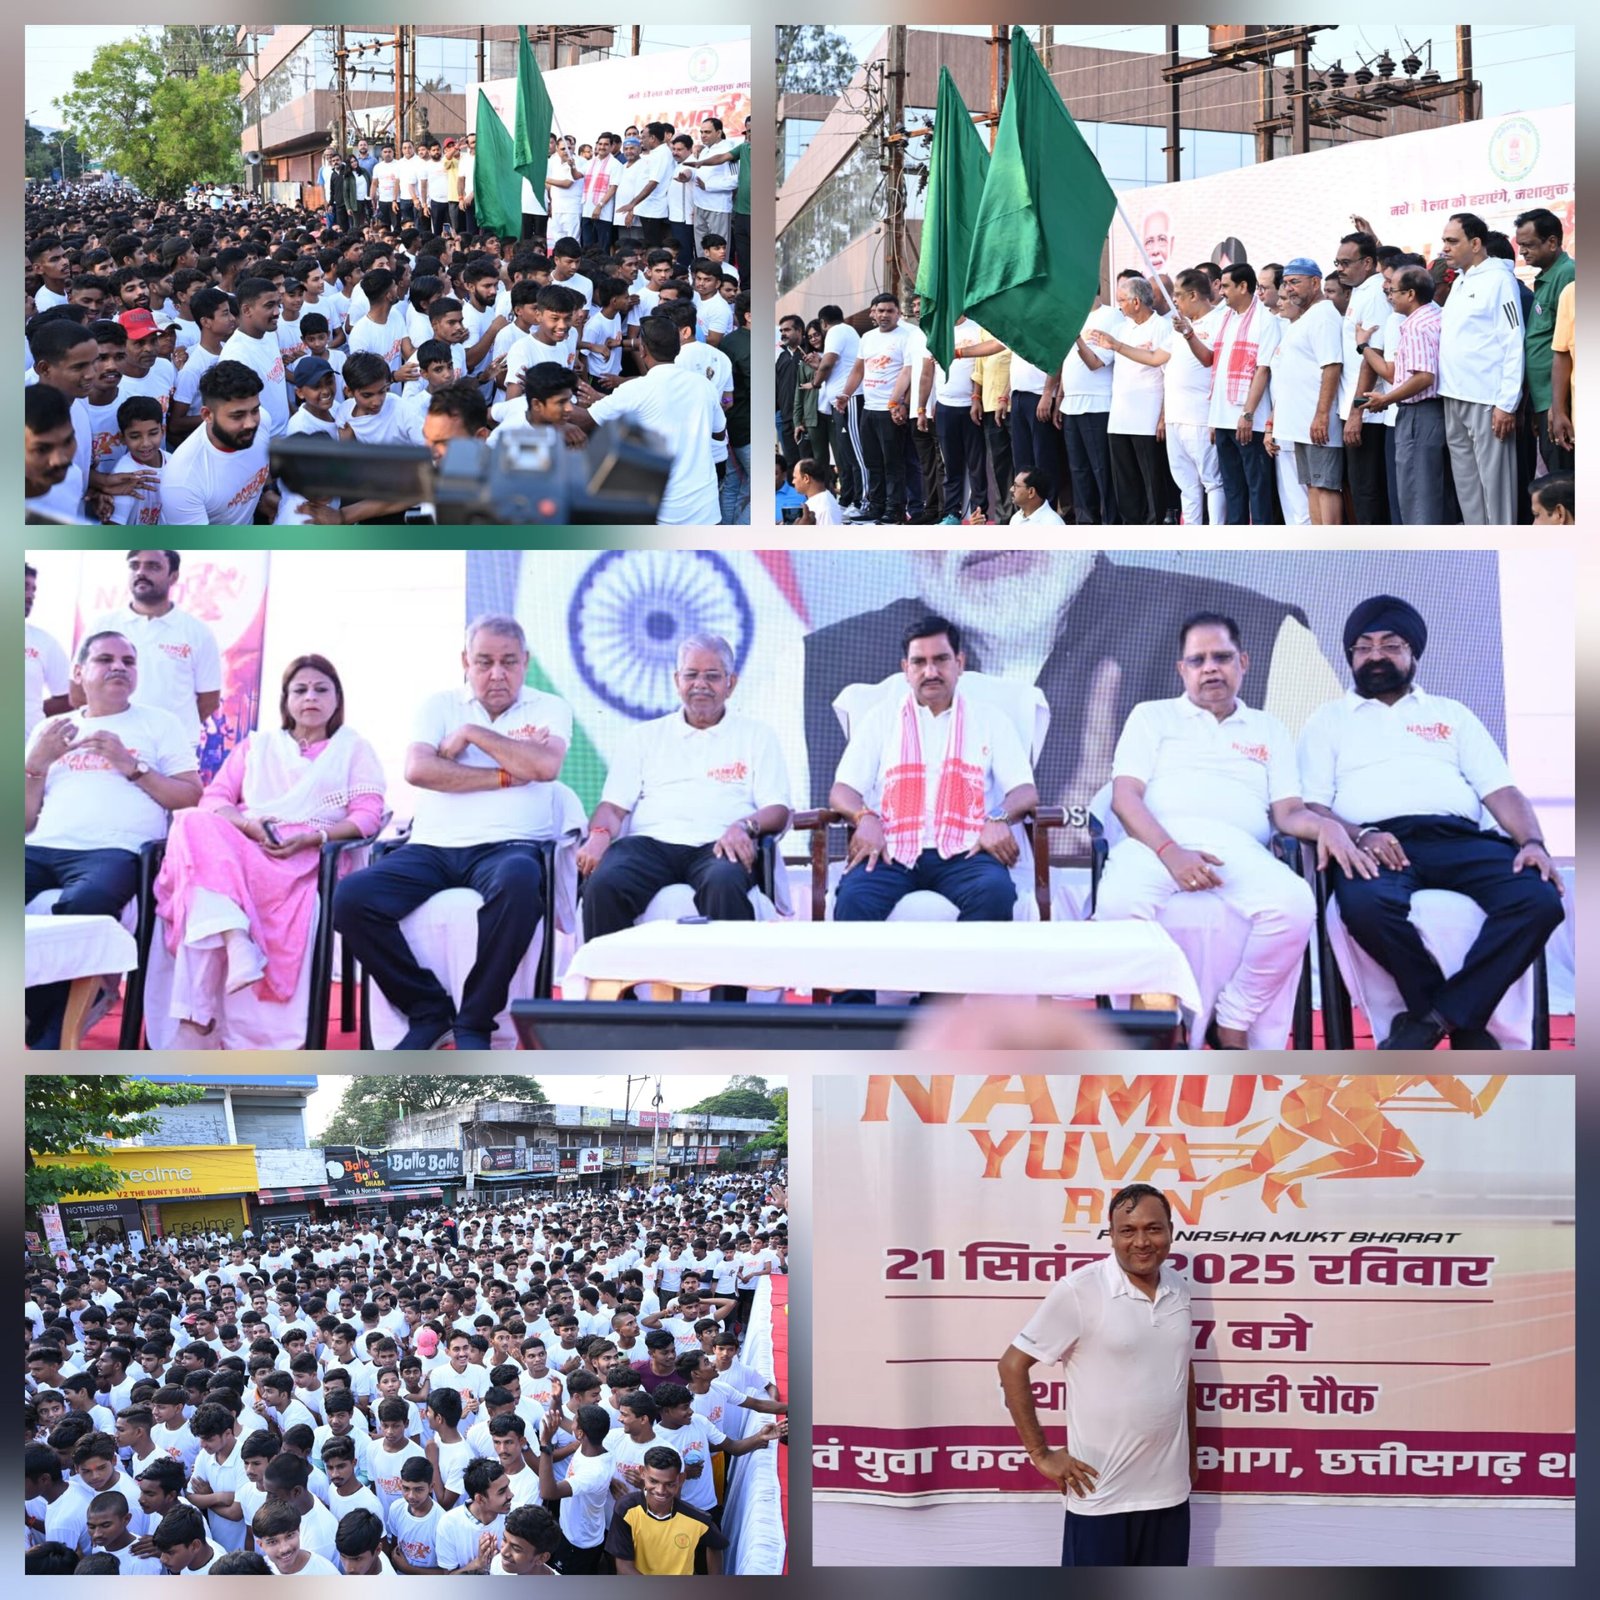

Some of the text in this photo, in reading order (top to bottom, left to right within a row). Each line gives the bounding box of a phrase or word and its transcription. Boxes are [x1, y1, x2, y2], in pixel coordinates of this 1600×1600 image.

[1390, 201, 1409, 216] नशे
[1429, 199, 1449, 211] लत
[1452, 193, 1467, 208] को
[1469, 189, 1511, 207] हराएंगे,
[1514, 183, 1570, 200] नशामुक्त
[343, 1158, 370, 1172] Balle
[392, 1151, 460, 1171] Balle Balle
[967, 1129, 1204, 1182] YUVA
[120, 1166, 193, 1183] realme
[353, 1169, 379, 1183] Balle
[116, 1191, 129, 1199] V2
[131, 1190, 146, 1198] THE
[182, 1187, 202, 1195] MALL
[65, 1203, 118, 1215] NOTHING (R)
[1062, 1187, 1204, 1225] RN
[171, 1216, 236, 1233] realme
[1174, 1231, 1463, 1244] NASHA MUKT BHARAT
[886, 1249, 945, 1281] 21
[1165, 1252, 1296, 1285] 2025
[1309, 1246, 1495, 1286] रविवार
[1191, 1312, 1313, 1351] 7 बजे
[1195, 1374, 1292, 1413] एमडी
[1298, 1375, 1379, 1414] चौक
[812, 1438, 844, 1471] वं
[851, 1445, 938, 1483] युवा
[1196, 1446, 1304, 1478] भाग,
[1315, 1441, 1527, 1485] छत्तीसगढ़
